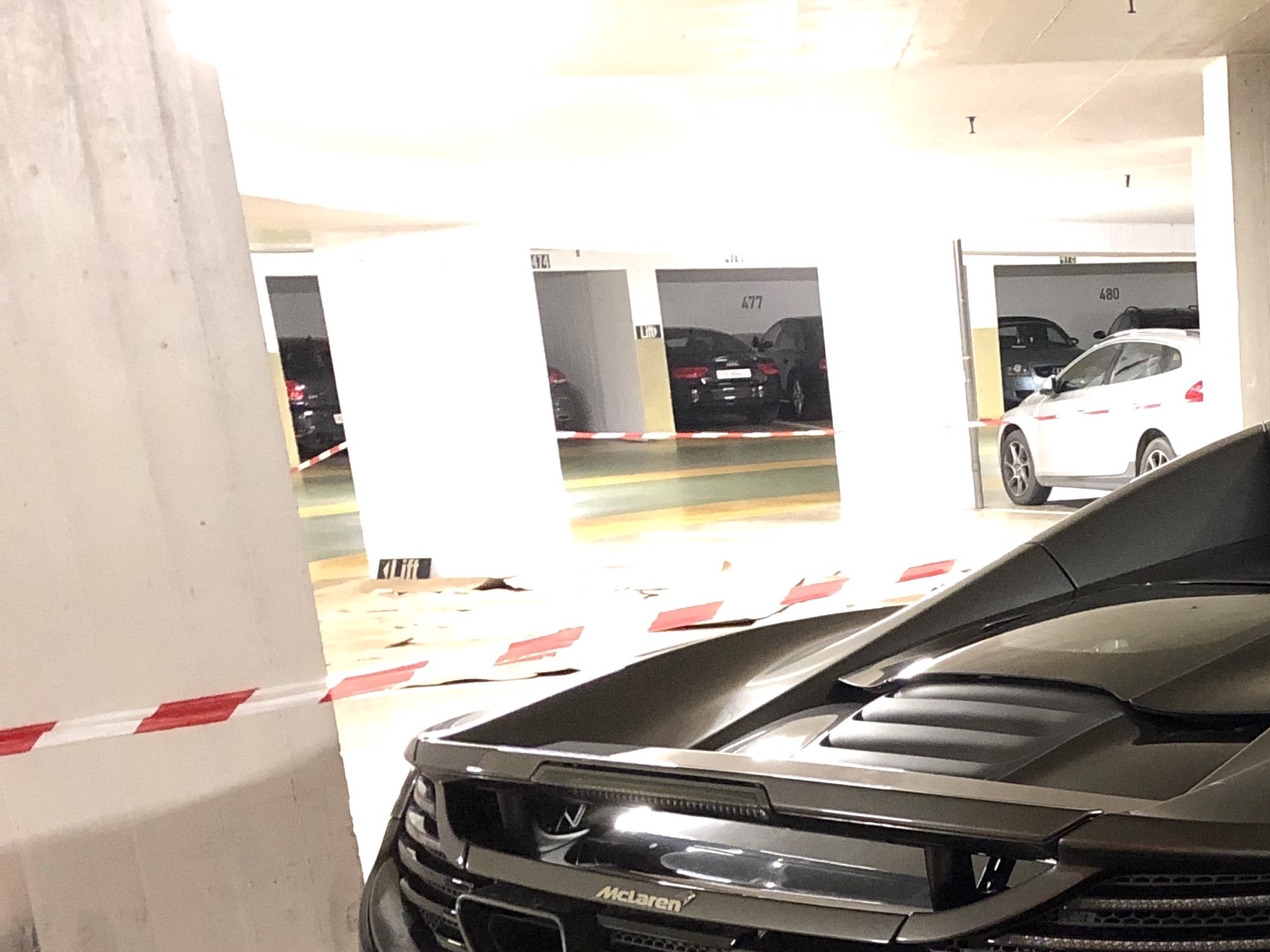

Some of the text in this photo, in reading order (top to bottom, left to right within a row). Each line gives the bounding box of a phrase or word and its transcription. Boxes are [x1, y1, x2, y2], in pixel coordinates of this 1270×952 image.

[741, 295, 763, 310] 477
[1099, 287, 1120, 301] 480
[389, 559, 419, 580] Lift
[594, 886, 682, 913] McLaren
